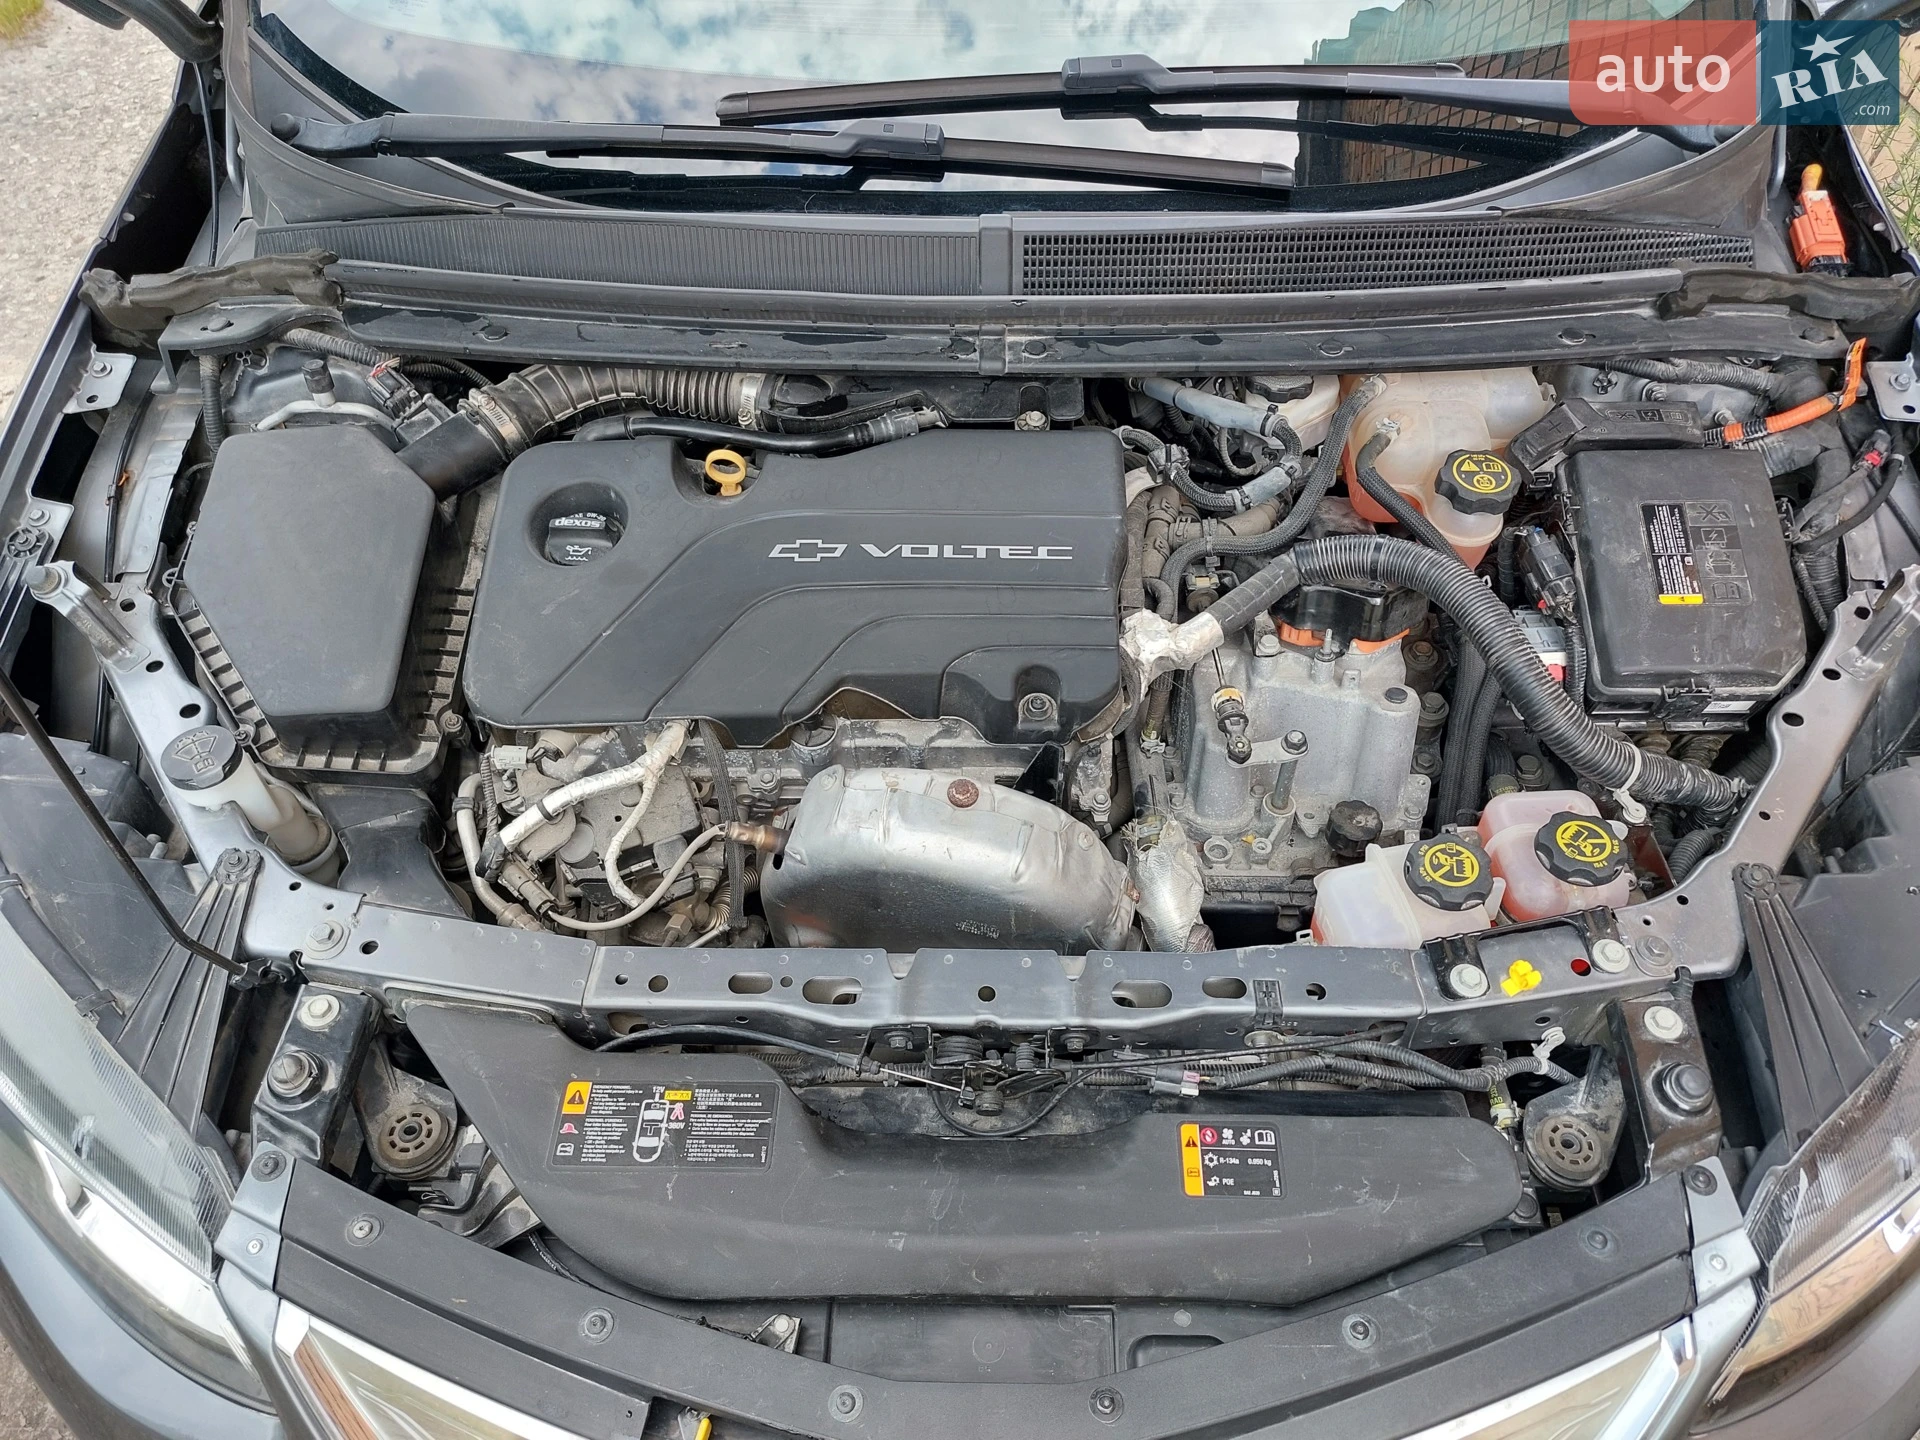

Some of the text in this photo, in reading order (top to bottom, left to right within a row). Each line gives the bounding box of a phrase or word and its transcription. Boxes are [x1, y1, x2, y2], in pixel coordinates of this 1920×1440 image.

[555, 517, 601, 528] dexos
[860, 543, 1073, 560] VOLTEC
[1489, 1096, 1503, 1105] RAD
[667, 1121, 686, 1130] 360V
[1219, 1157, 1239, 1165] R-134a
[1222, 1178, 1235, 1186] POE
